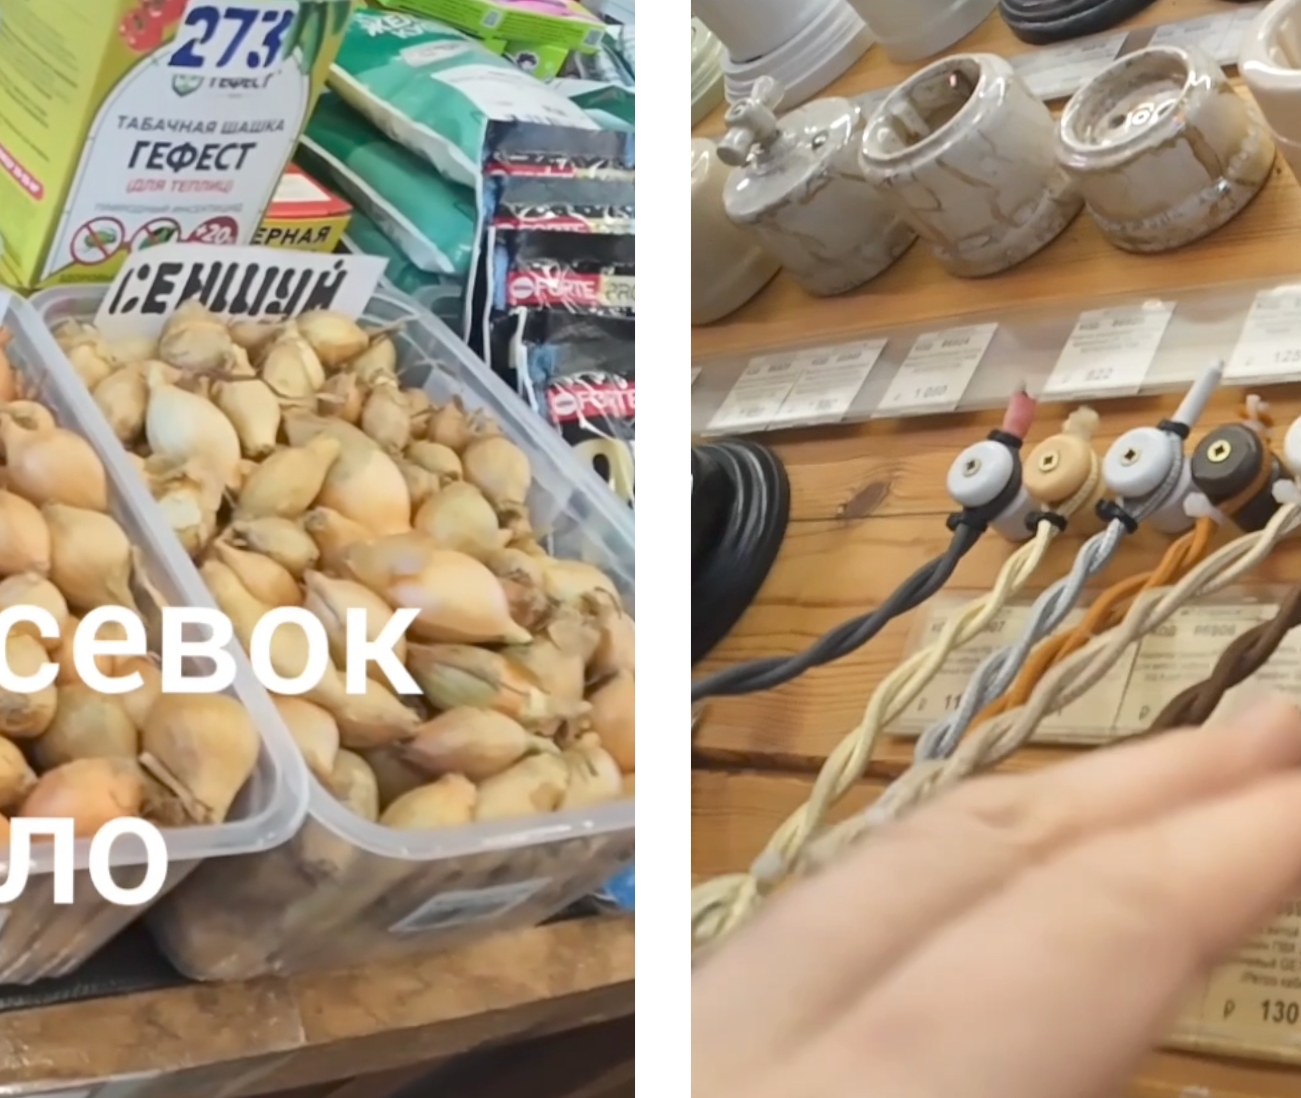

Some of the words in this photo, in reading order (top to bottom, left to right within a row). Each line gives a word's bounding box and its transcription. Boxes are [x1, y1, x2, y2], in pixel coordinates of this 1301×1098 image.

[168, 5, 295, 68] 273
[117, 114, 217, 133] ТАБАЧНАЯ
[221, 119, 285, 134] ШАШКА
[127, 140, 257, 171] ГЕФЕСТ
[534, 280, 597, 300] FORTE
[1261, 999, 1300, 1025] 130
